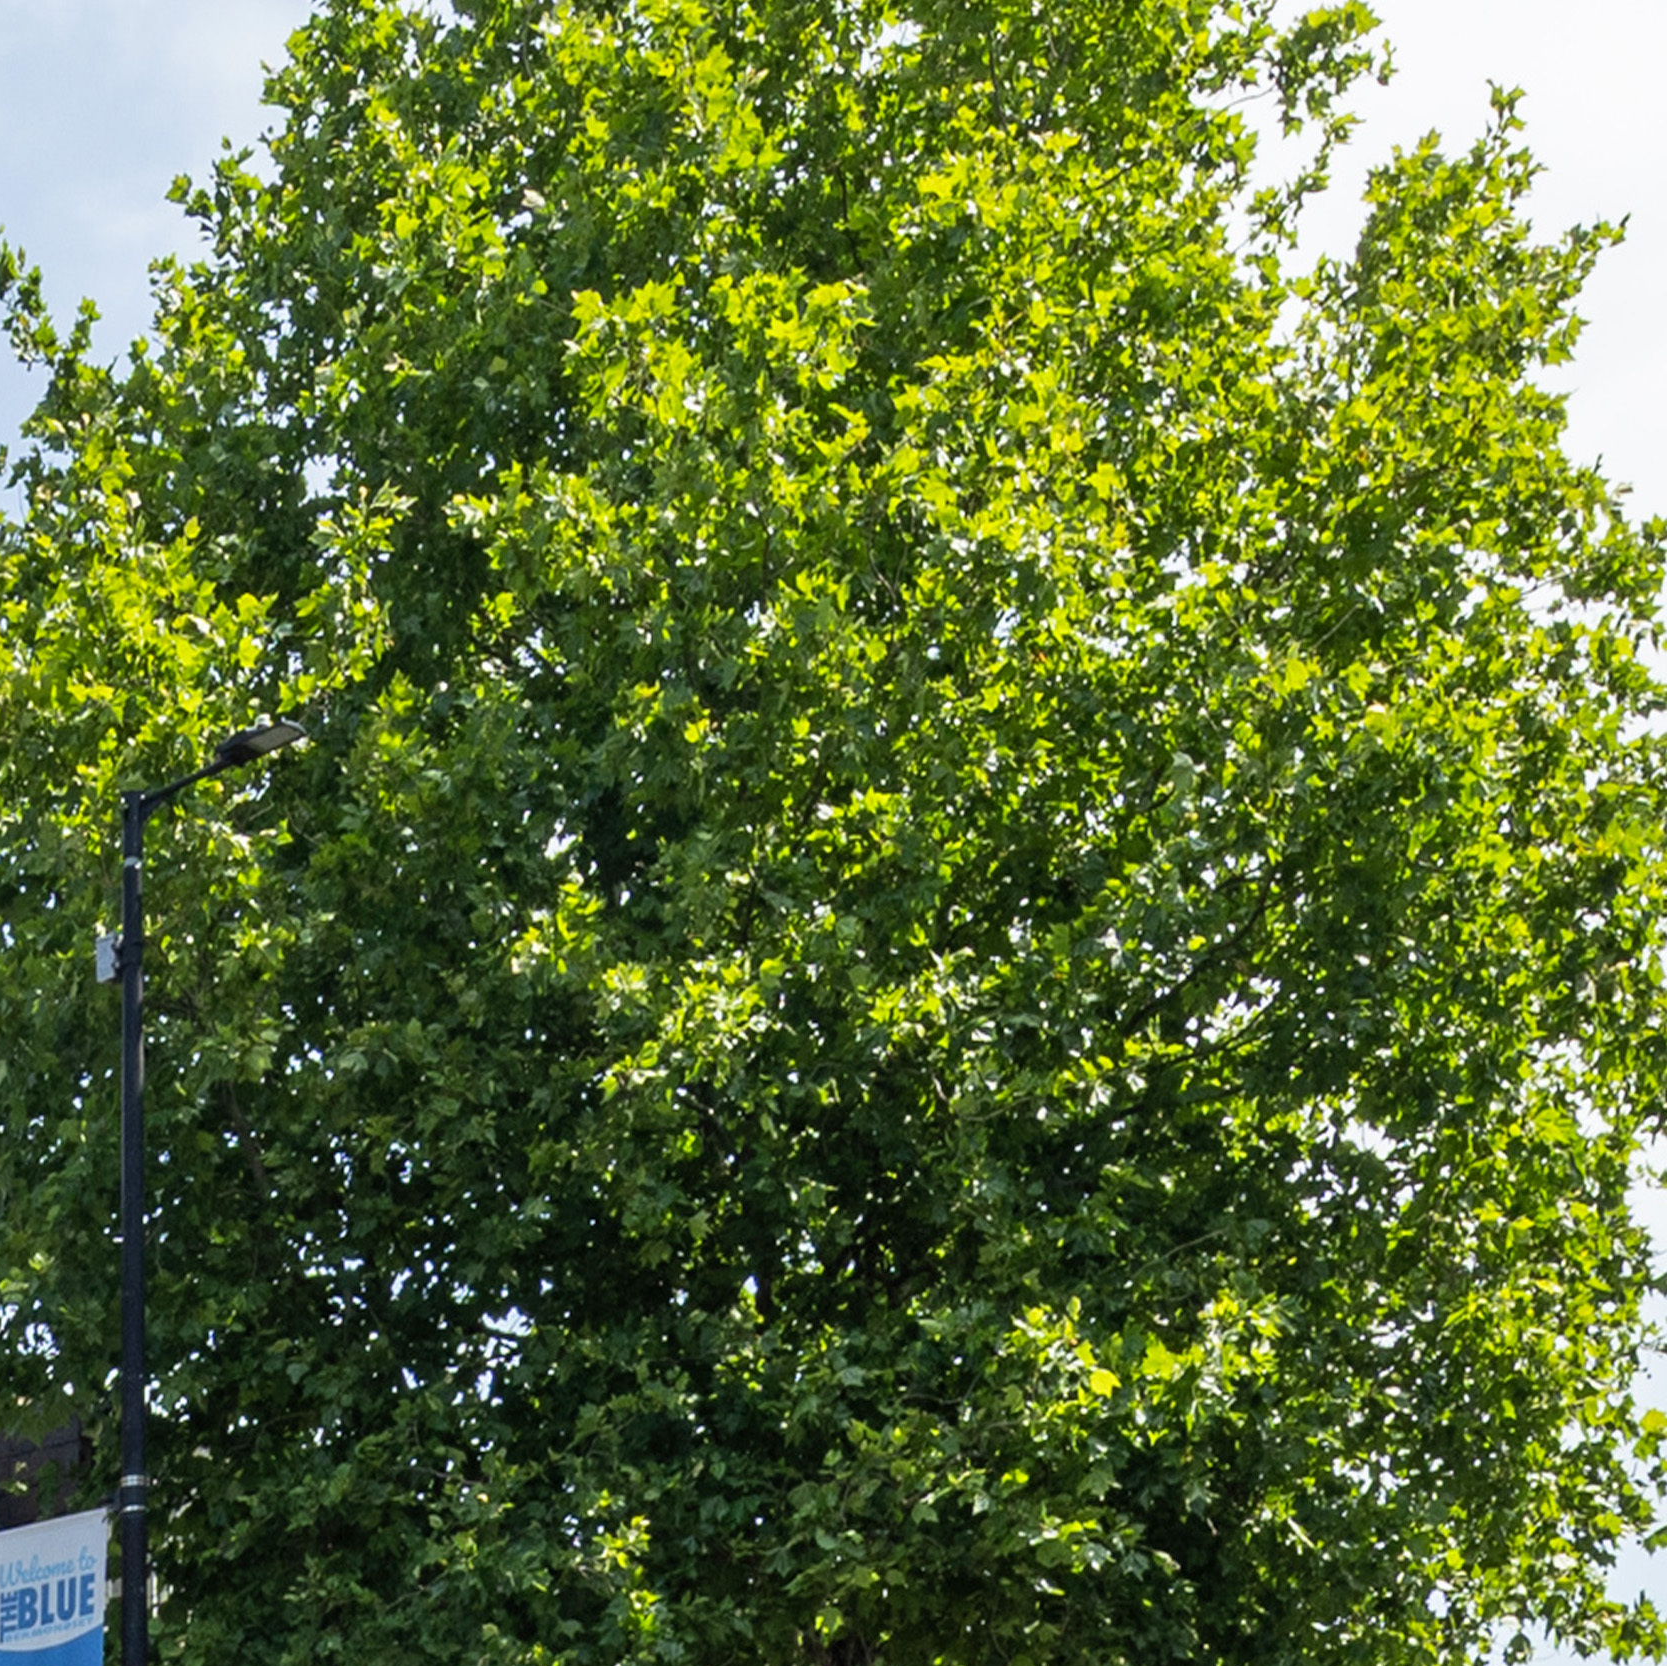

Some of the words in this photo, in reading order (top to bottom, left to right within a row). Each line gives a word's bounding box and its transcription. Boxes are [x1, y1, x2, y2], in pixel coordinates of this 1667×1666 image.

[0, 1554, 74, 1588] Welcome
[78, 1546, 98, 1571] to
[0, 1592, 18, 1644] THE
[18, 1573, 95, 1630] BLUE
